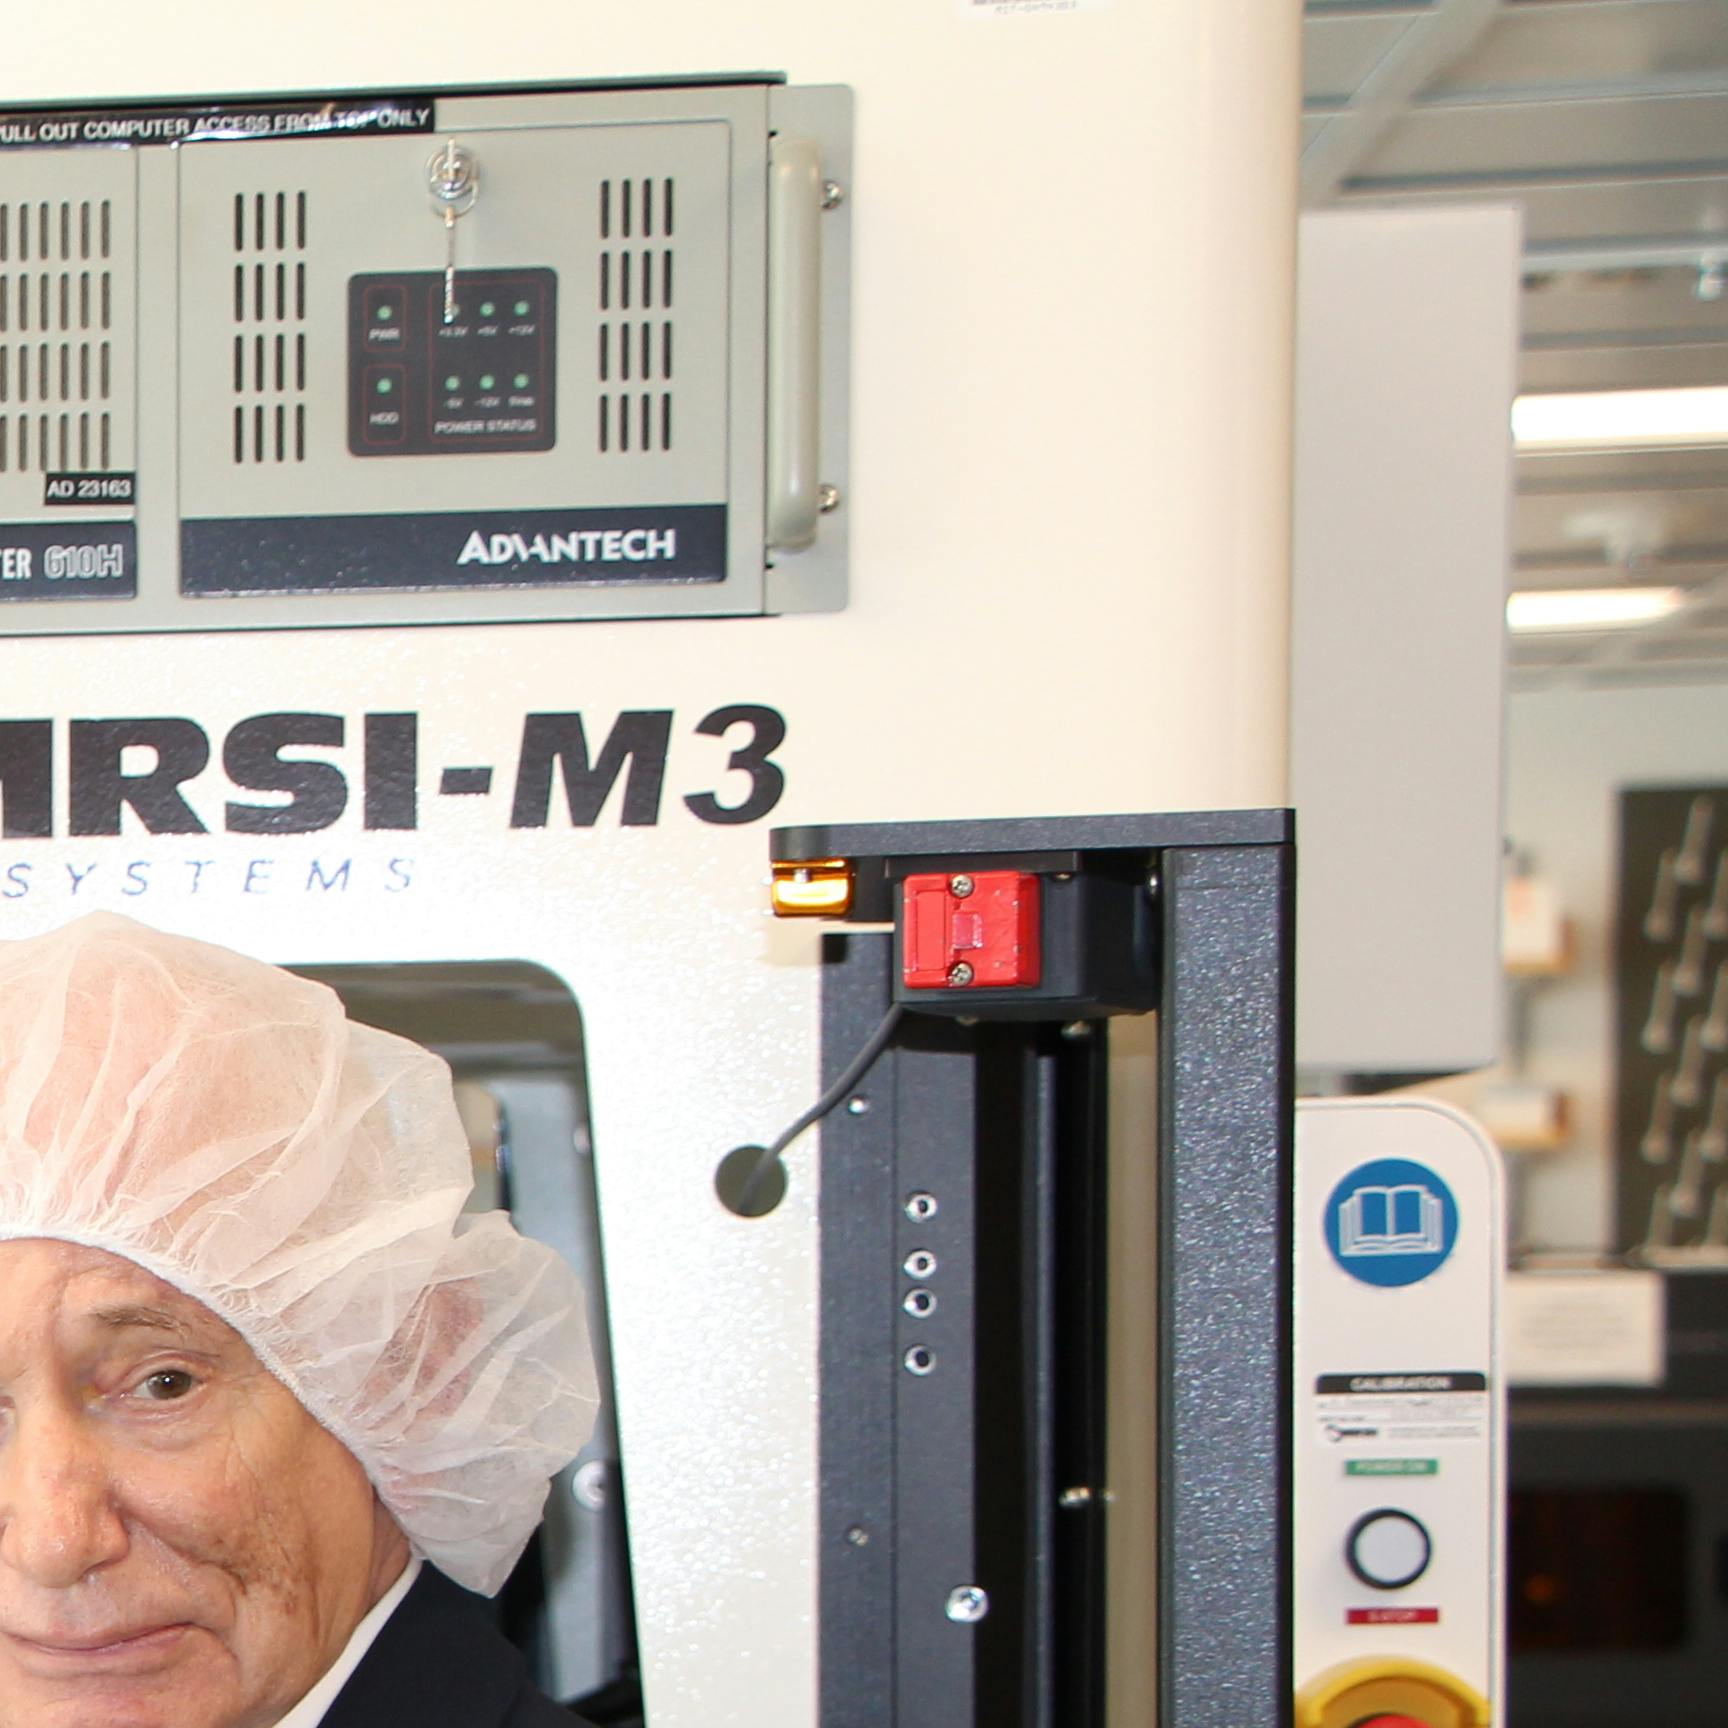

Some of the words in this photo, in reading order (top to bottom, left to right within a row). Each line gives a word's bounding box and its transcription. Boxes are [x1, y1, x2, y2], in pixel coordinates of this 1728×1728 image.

[39, 121, 80, 142] OUT
[83, 118, 190, 140] COMPUTER
[194, 113, 271, 134] ACCESS
[376, 107, 431, 128] ONLY
[369, 412, 399, 425] HDD
[434, 419, 485, 434] POWER
[487, 418, 537, 432] STATUS
[47, 481, 75, 497] AD
[77, 480, 133, 498] 23163
[44, 543, 124, 580] 610H
[456, 528, 676, 565] ADVANTECH
[4, 857, 416, 900] SYSTEMS
